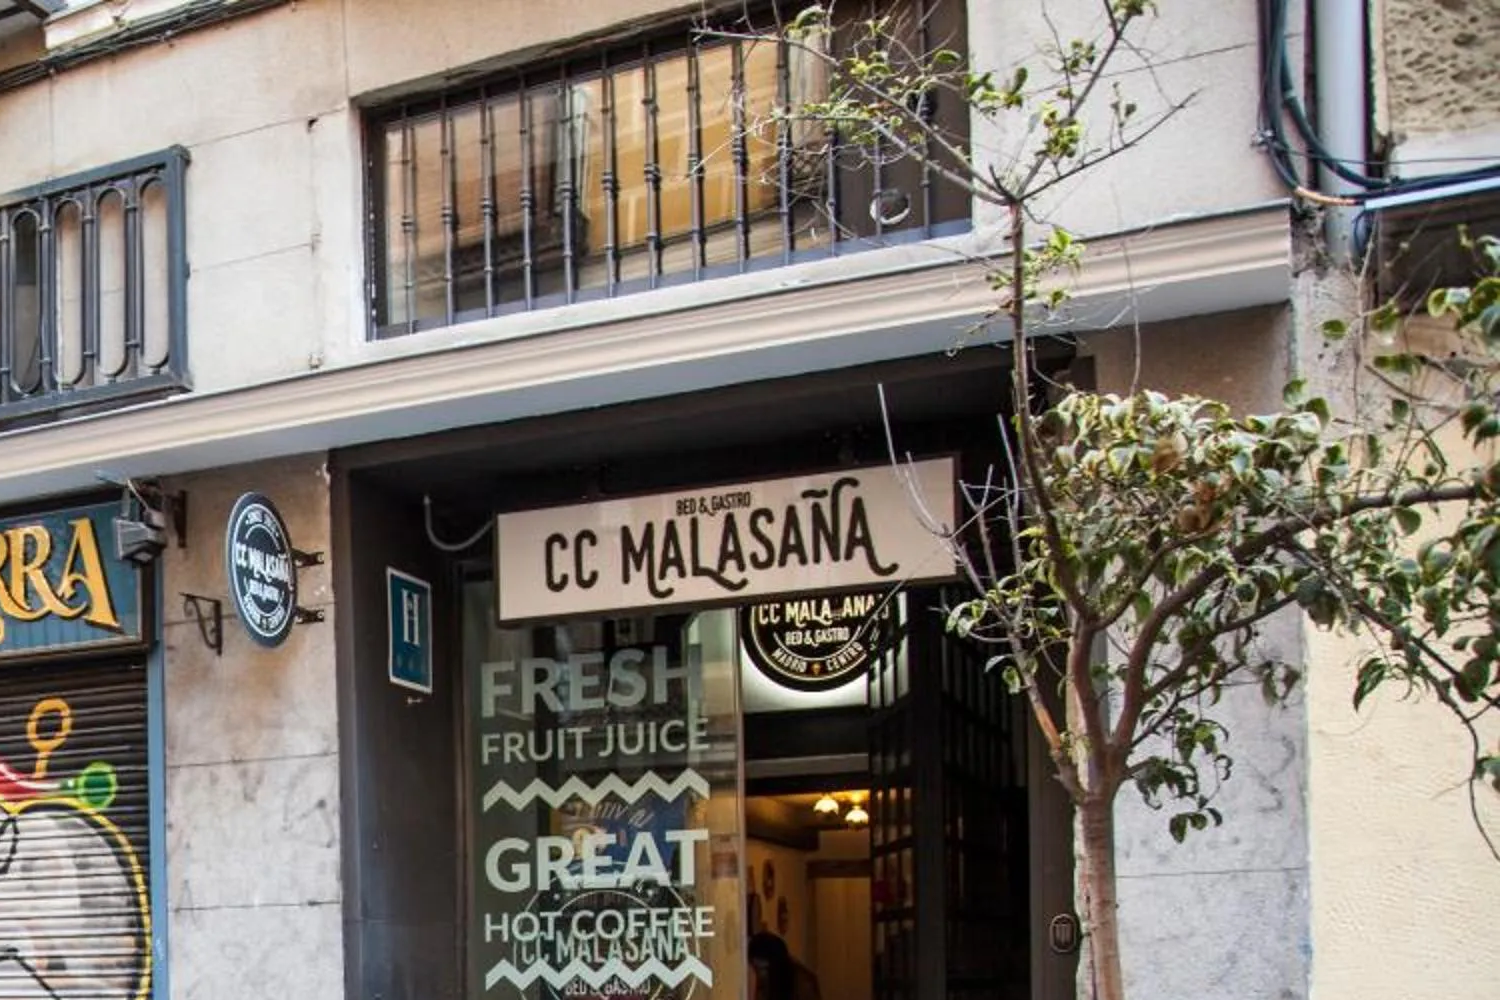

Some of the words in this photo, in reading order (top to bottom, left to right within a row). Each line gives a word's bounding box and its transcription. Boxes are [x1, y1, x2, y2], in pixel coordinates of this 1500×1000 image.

[676, 497, 697, 516] BED
[699, 496, 717, 517] &
[711, 491, 751, 511] GASTRO
[545, 528, 599, 592] CC
[620, 477, 899, 598] MALASAÑA
[758, 603, 781, 625] CC
[785, 631, 803, 646] BED
[815, 627, 850, 643] GASTRO
[481, 646, 702, 718] FRESH
[481, 726, 592, 765] FRUIT
[598, 717, 711, 758] JUICE
[485, 829, 709, 893] GREAT
[485, 913, 562, 943] HOT
[571, 906, 715, 940] COFFEE
